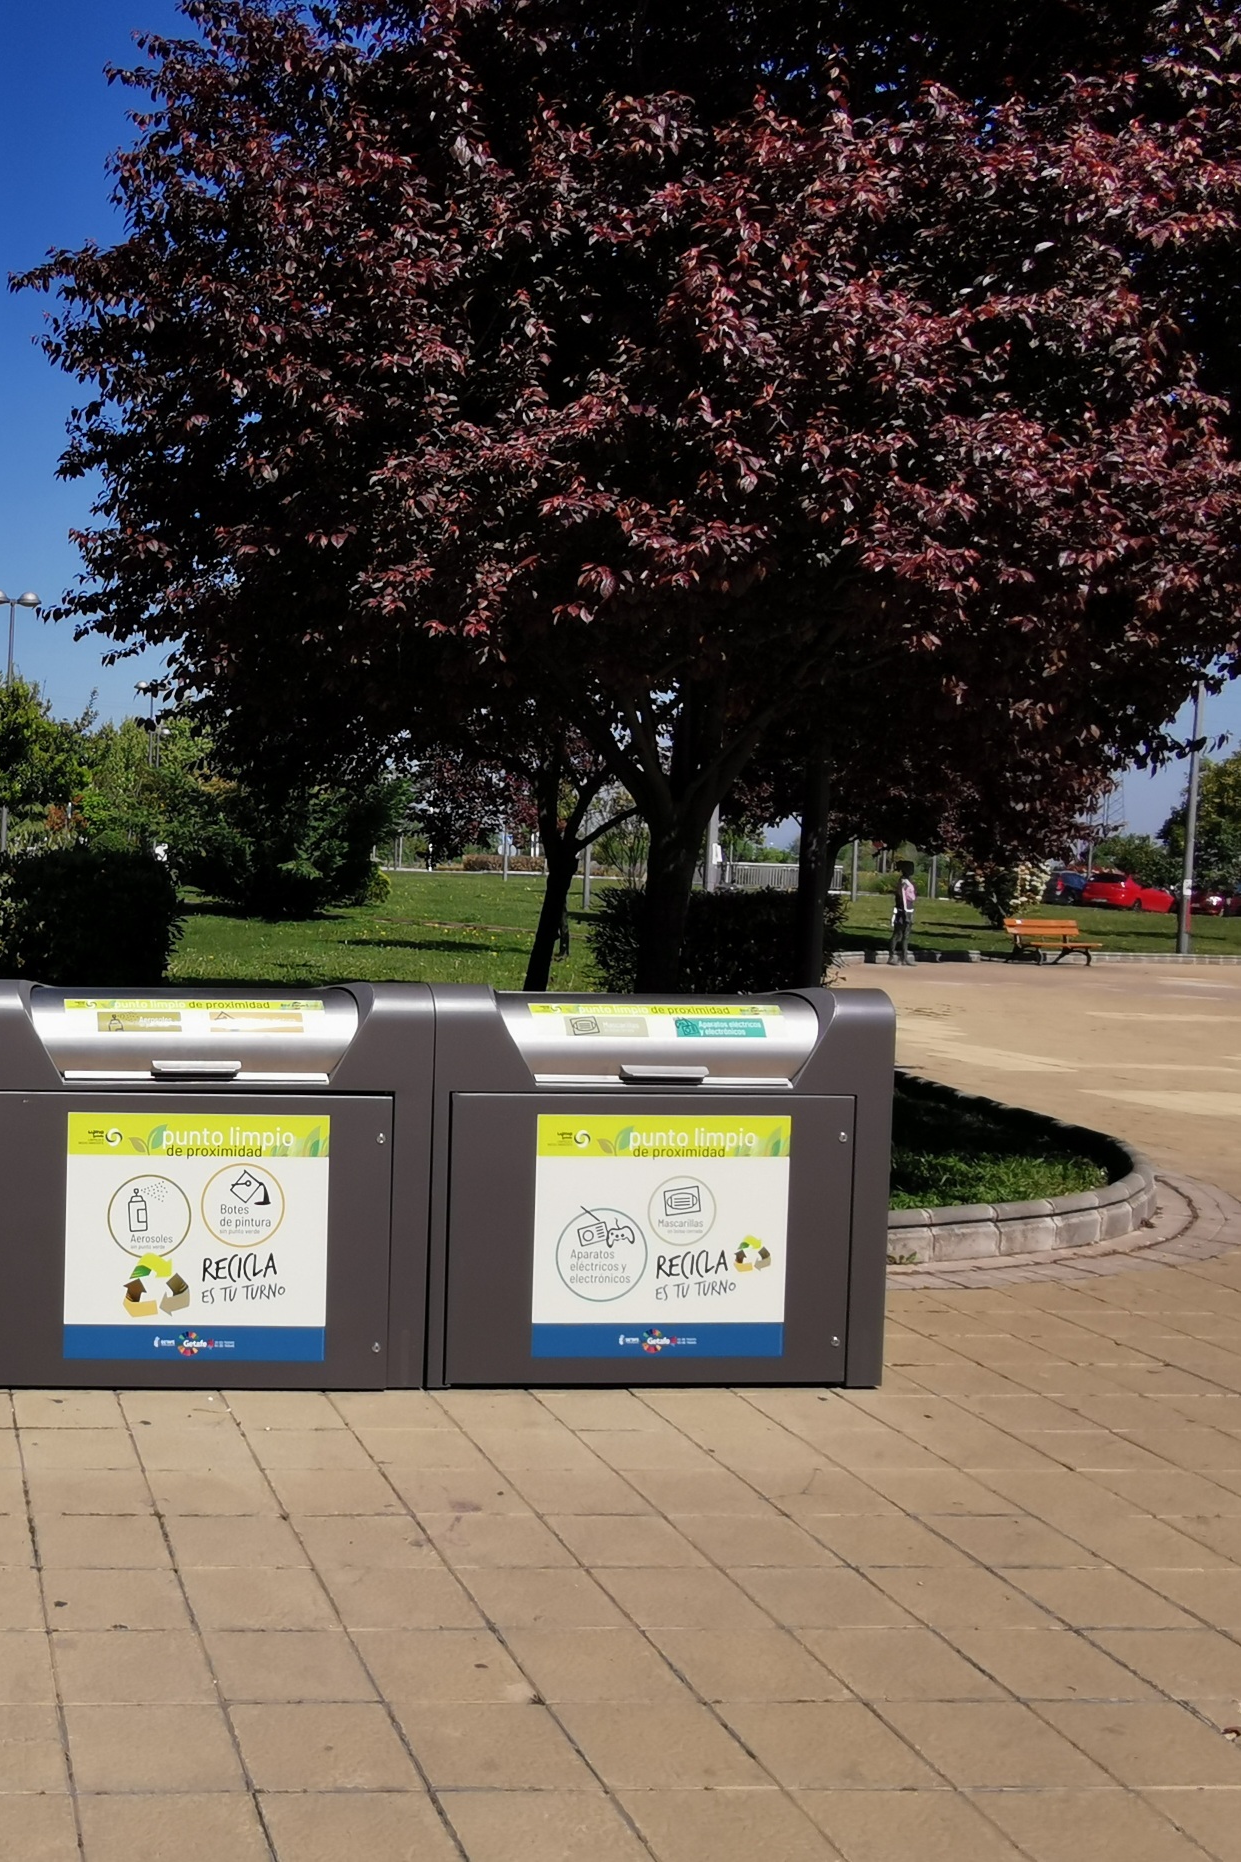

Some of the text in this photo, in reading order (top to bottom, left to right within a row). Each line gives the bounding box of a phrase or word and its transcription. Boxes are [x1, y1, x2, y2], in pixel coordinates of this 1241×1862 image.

[114, 1000, 148, 1010] punto
[150, 1000, 186, 1010] limpio
[188, 1001, 203, 1009] de
[206, 1001, 270, 1010] proximidad
[578, 1005, 611, 1015] punto
[614, 1005, 649, 1015] limpio
[651, 1006, 665, 1014] de
[668, 1006, 730, 1016] proximidad
[698, 1020, 728, 1029] Aparatos
[162, 1127, 294, 1150] punto limpio
[628, 1128, 757, 1151] punto limpio
[166, 1145, 263, 1160] de proximidad
[632, 1146, 726, 1161] de proximidad
[220, 1204, 250, 1215] Botes
[220, 1216, 271, 1229] de pintura
[658, 1218, 704, 1228] Mascarillas
[130, 1234, 174, 1244] Aerosoles
[570, 1249, 615, 1260] Aparatos
[202, 1252, 278, 1282] RECICLA
[570, 1261, 627, 1273] eléctricos y
[656, 1250, 728, 1280] RECICLA
[569, 1272, 631, 1284] electrónicos
[202, 1282, 286, 1304] ES TU TURNO
[655, 1279, 737, 1301] ES TU TURNO
